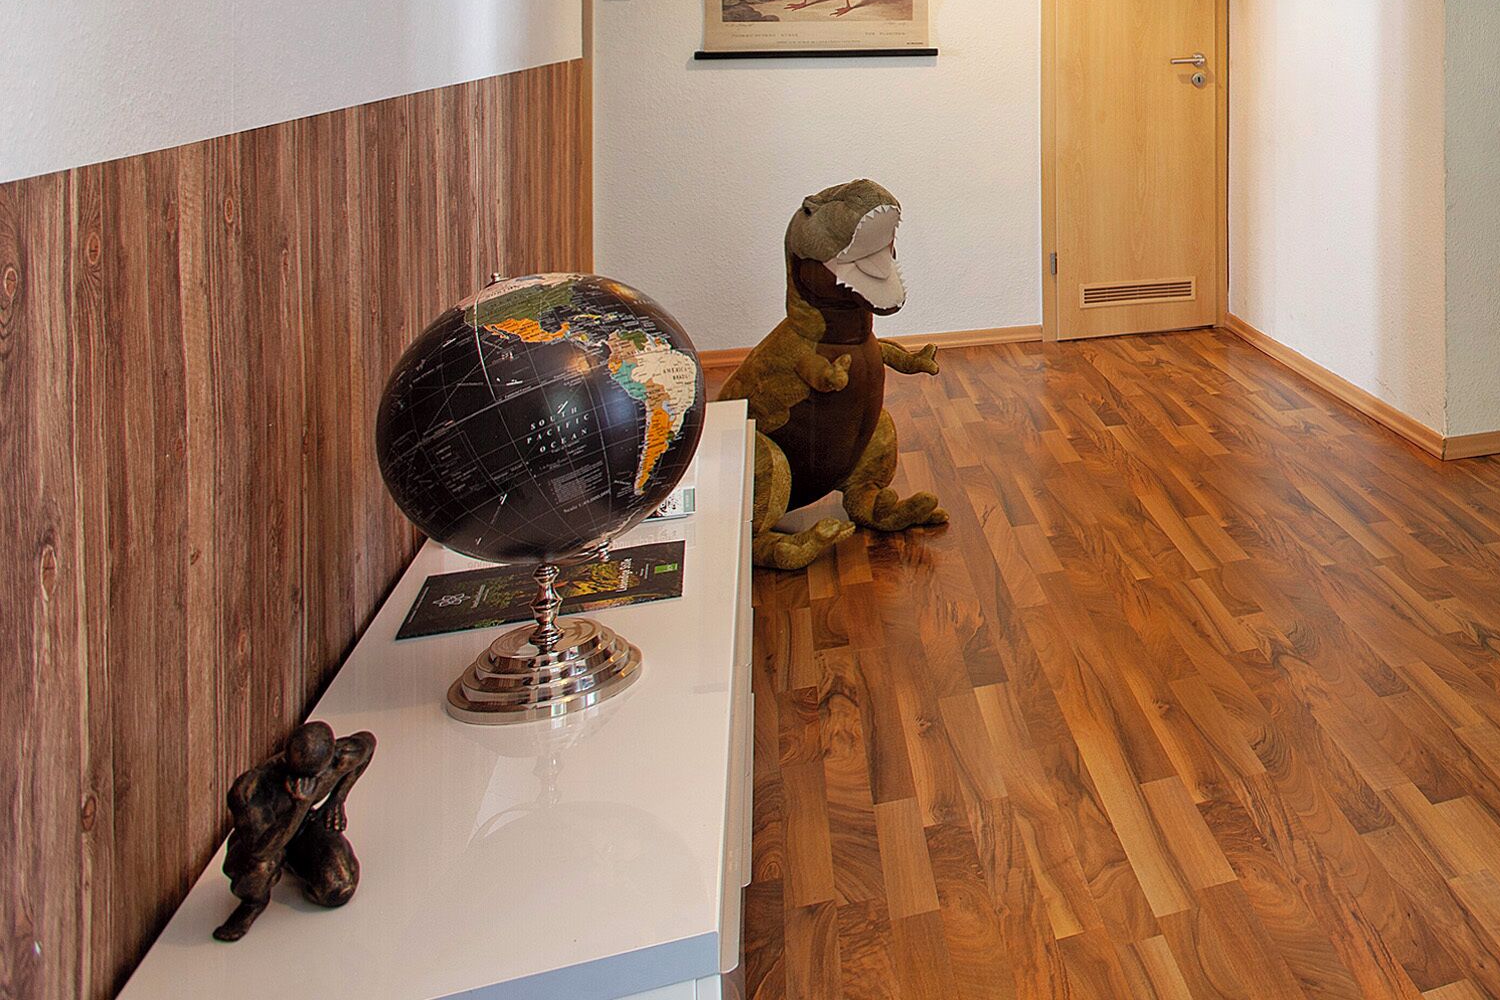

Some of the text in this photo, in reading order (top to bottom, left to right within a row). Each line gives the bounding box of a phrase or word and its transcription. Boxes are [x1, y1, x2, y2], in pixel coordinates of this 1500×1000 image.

[526, 413, 589, 444] PACIFIC
[530, 407, 577, 430] SOUTH
[540, 428, 588, 453] OCEAN
